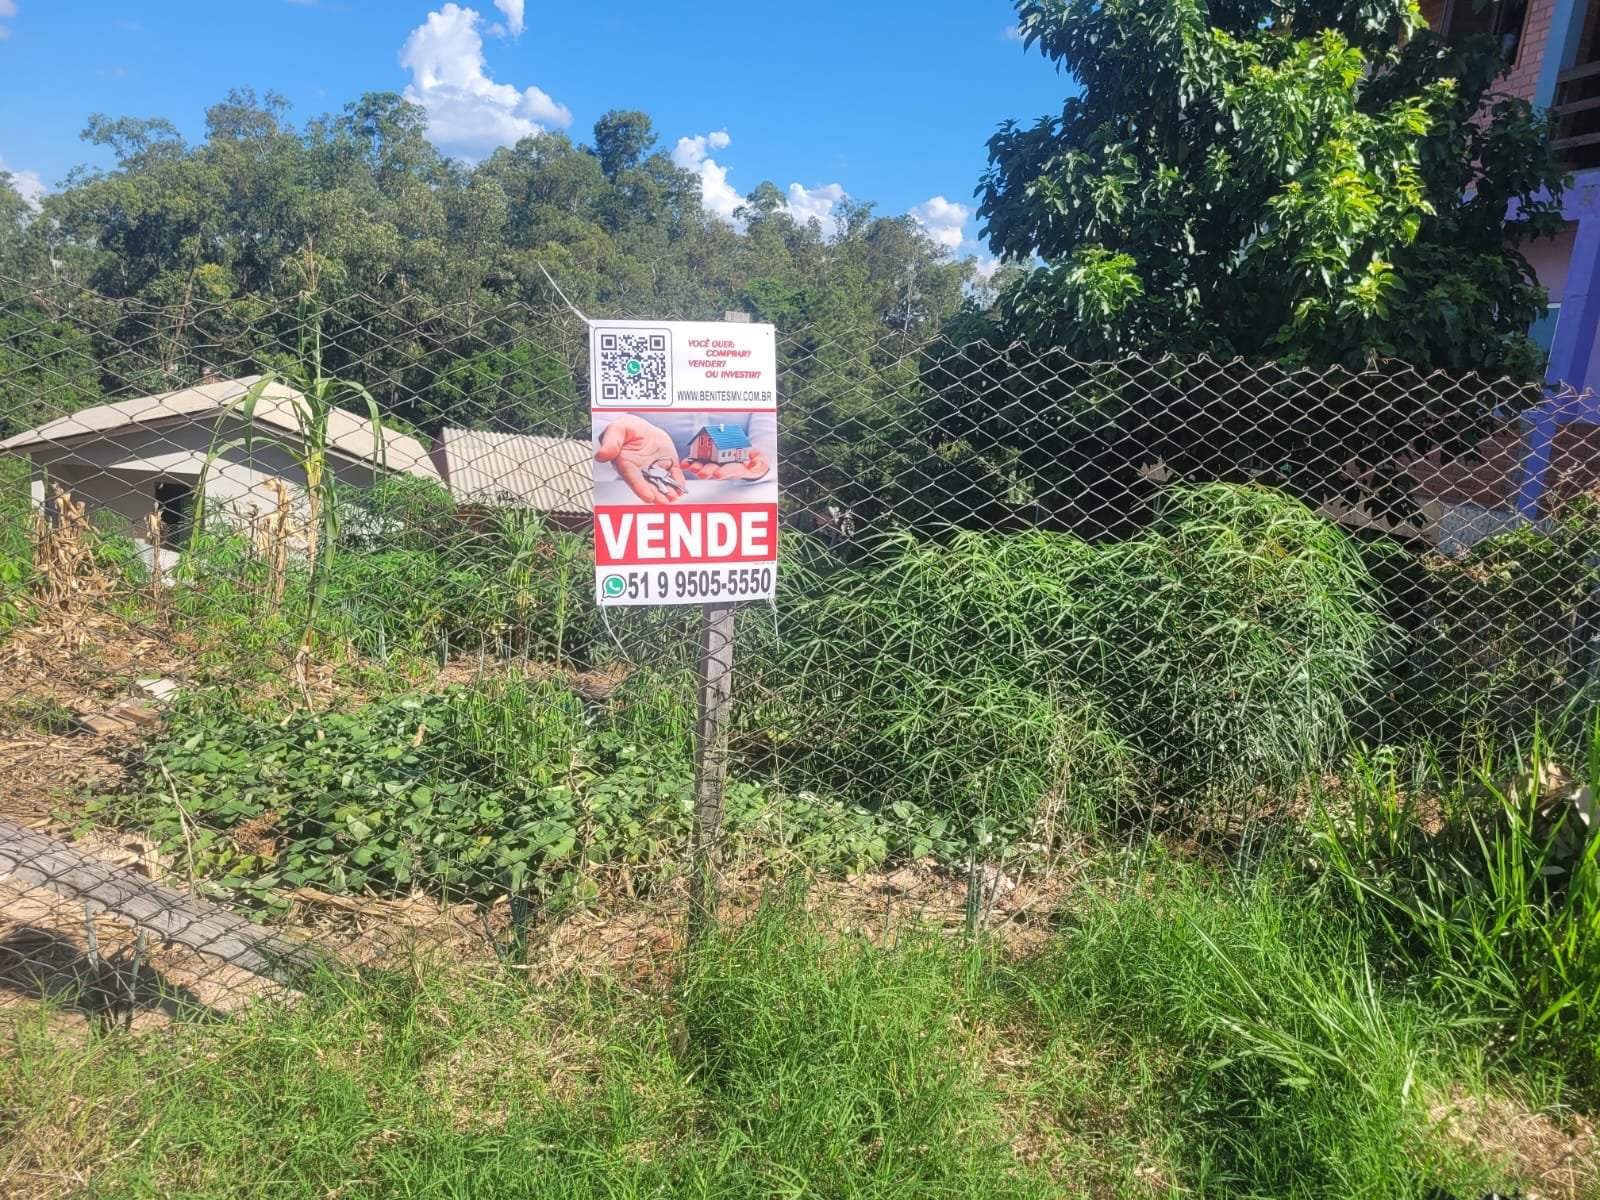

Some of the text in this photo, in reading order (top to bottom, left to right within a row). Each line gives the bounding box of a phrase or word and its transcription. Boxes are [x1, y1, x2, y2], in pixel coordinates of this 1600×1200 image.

[688, 338, 710, 348] VOCÊ
[705, 349, 752, 358] COMPRAR?
[688, 359, 727, 368] VENDER?
[705, 370, 762, 379] OU INVESTIR?
[677, 390, 772, 402] WWW.BENITESMV.COM.BR
[597, 511, 769, 560] VENDE
[628, 567, 771, 599] 51 9 9505-5550
